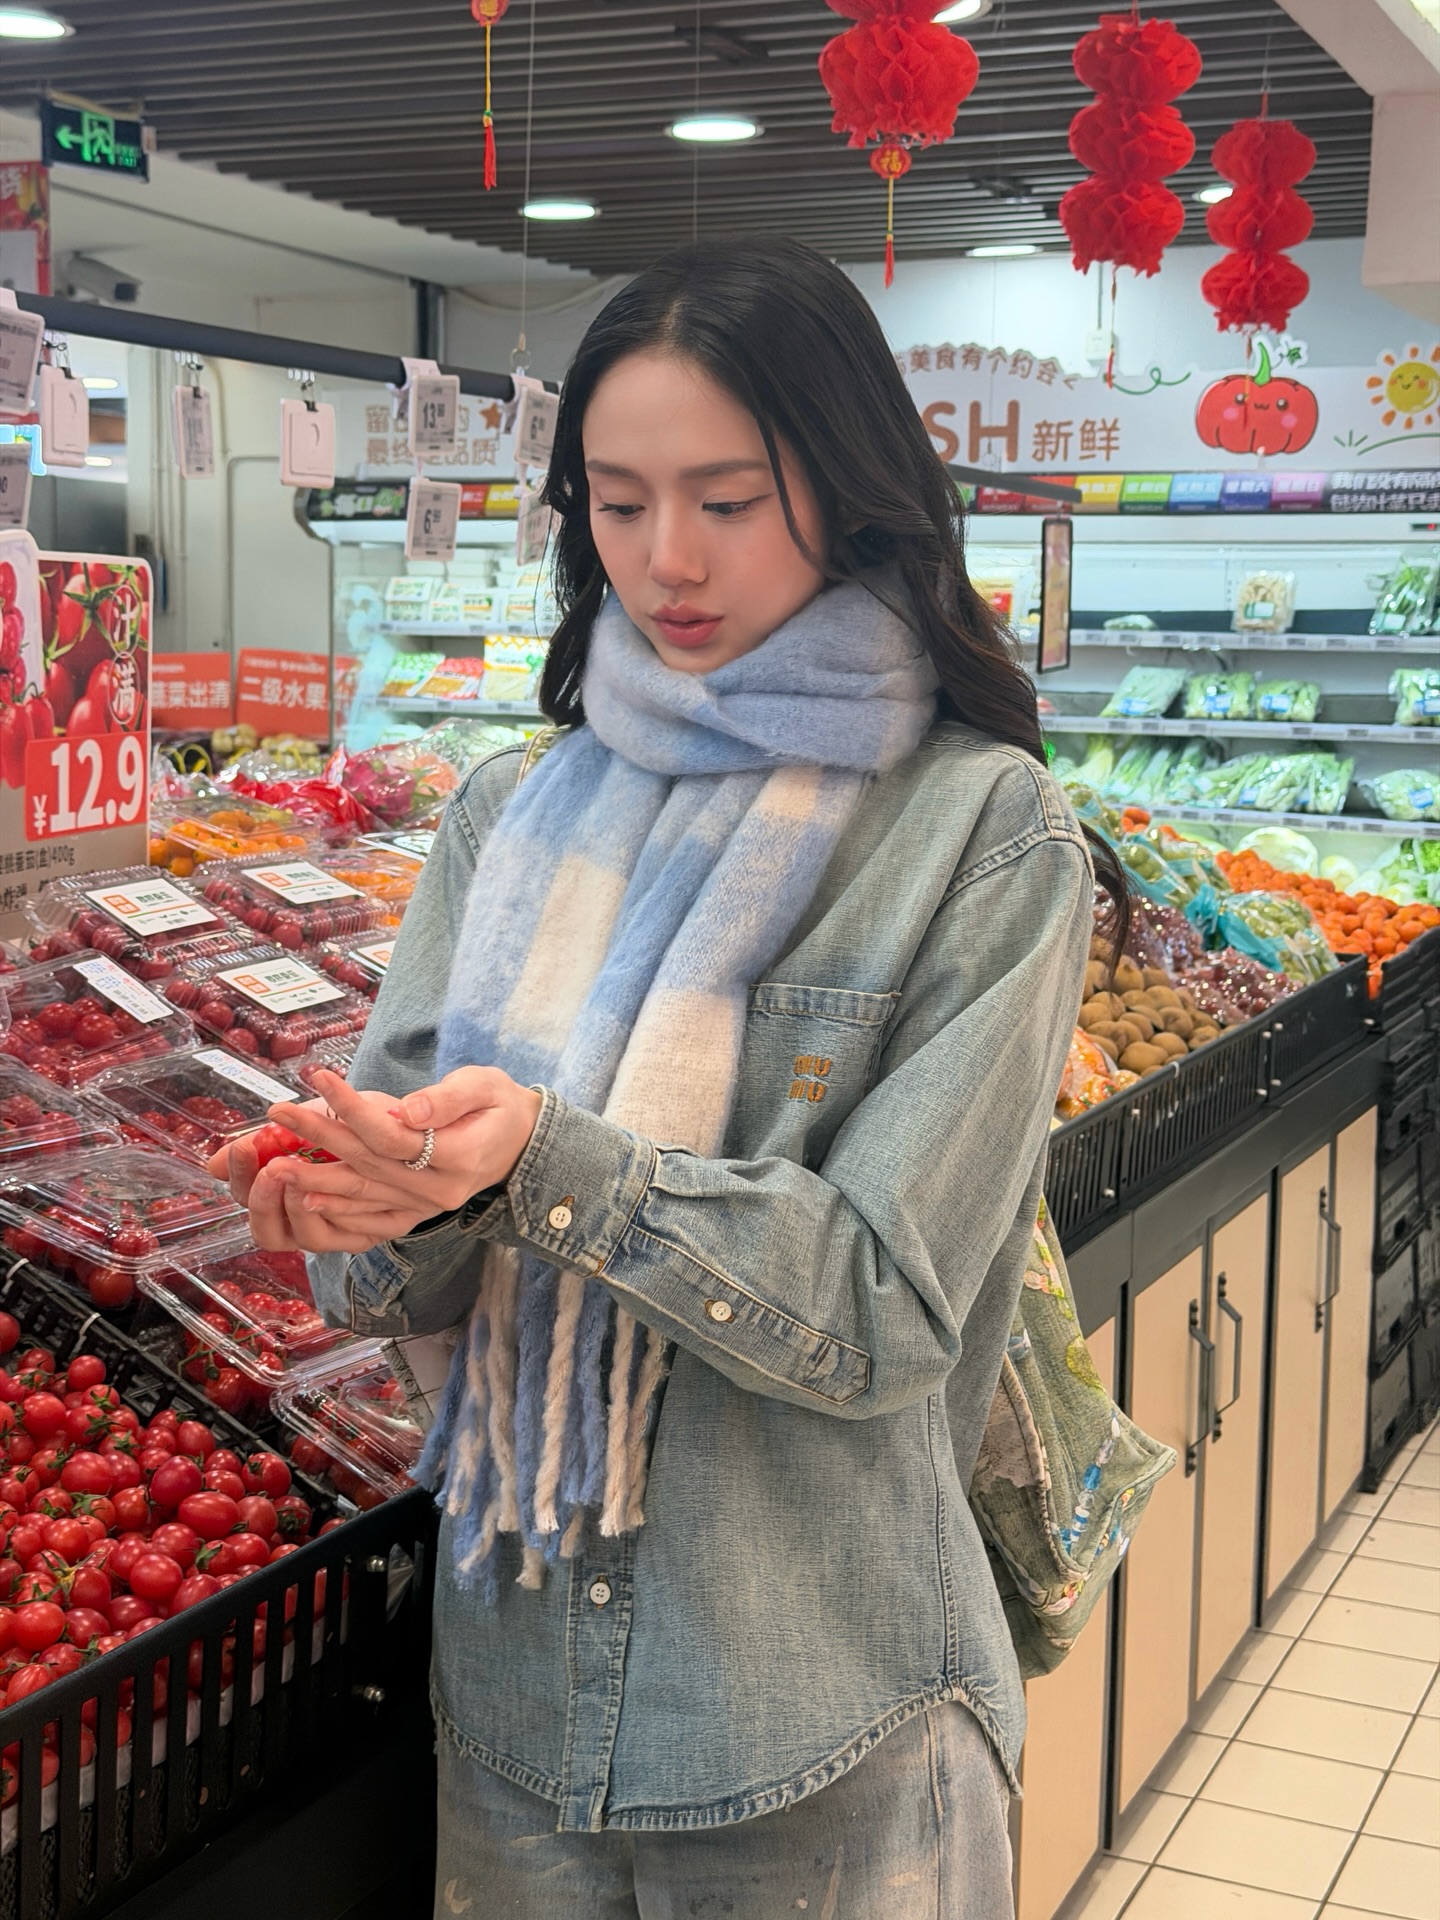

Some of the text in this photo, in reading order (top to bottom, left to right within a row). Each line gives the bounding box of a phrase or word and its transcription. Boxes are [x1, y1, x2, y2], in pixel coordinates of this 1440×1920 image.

[898, 345, 1061, 386] 美食有个约会
[367, 438, 498, 465] 最终品质
[1031, 417, 1120, 463] 新鲜
[239, 676, 326, 711] 二级水果
